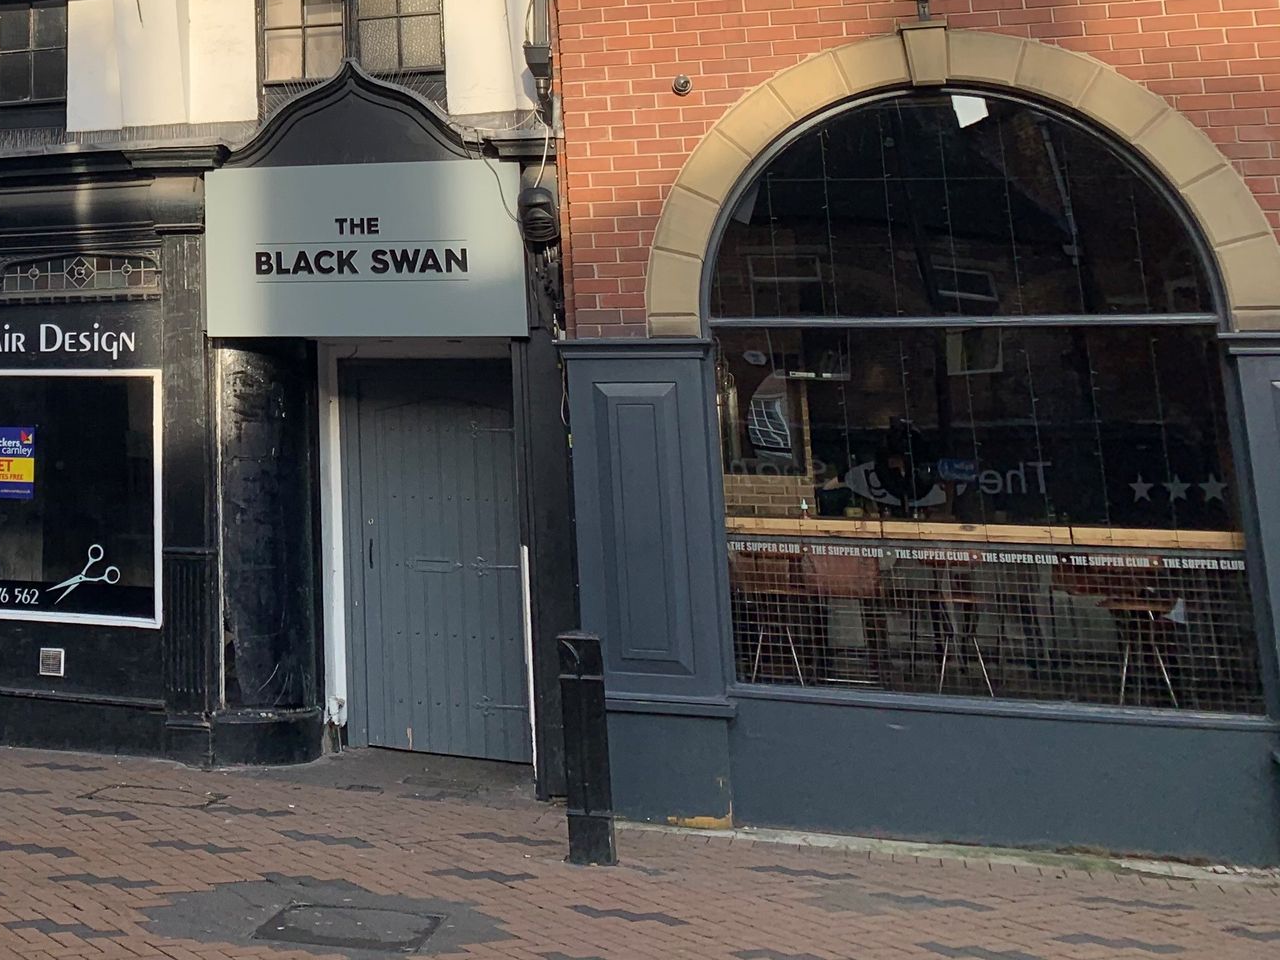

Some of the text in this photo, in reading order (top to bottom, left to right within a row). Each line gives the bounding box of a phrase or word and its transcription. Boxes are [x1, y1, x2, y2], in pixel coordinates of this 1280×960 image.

[335, 217, 380, 235] THE
[255, 248, 469, 275] BLACK SWAN
[1, 444, 32, 457] carnley
[730, 541, 1245, 570] THE SUPPER CLUB THE SUPPER CLUB THE SUPPER CLUB THE SUPPER CLUB THE SUPPER CLUB THE SUPPER CLUB
[14, 588, 39, 604] 562
